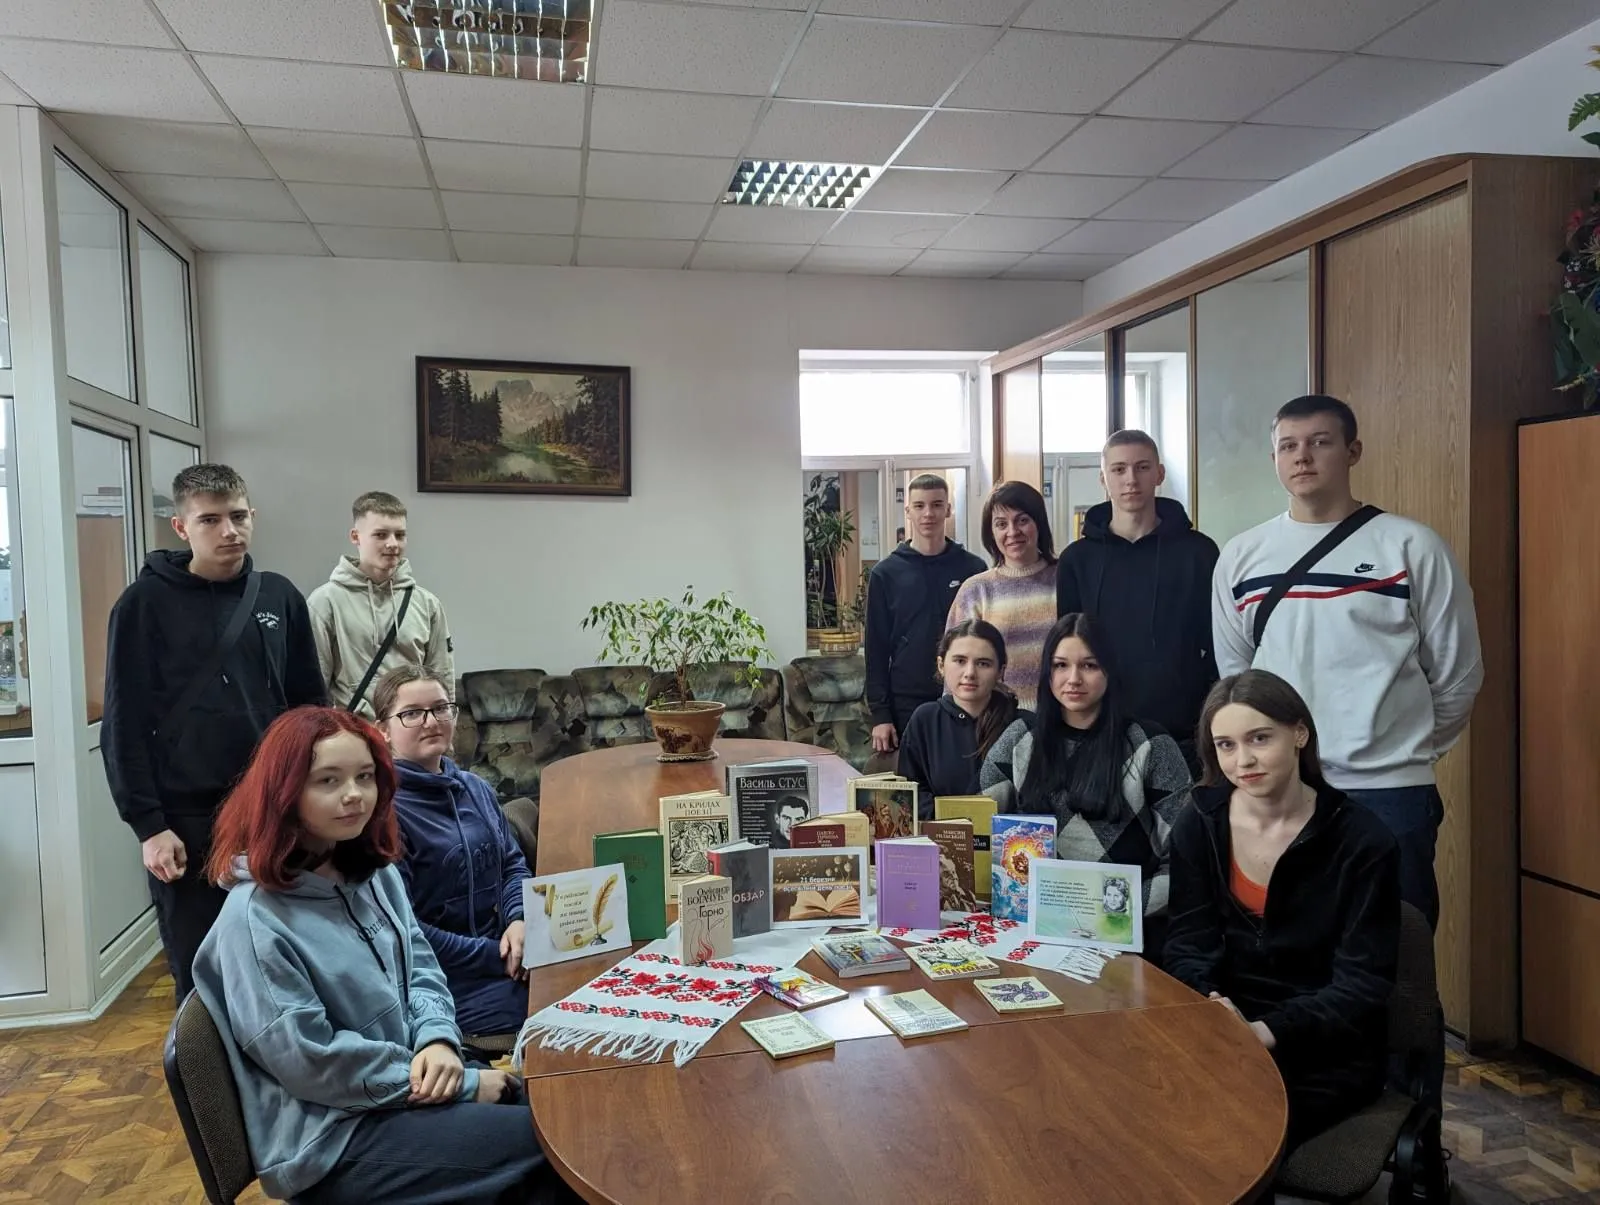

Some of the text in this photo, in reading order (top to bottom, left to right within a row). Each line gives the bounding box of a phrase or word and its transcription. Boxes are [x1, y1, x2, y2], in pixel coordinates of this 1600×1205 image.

[740, 776, 805, 788] Василь СТУС
[689, 801, 720, 809] КРИЛАХ
[733, 890, 765, 904] ОБЗАР
